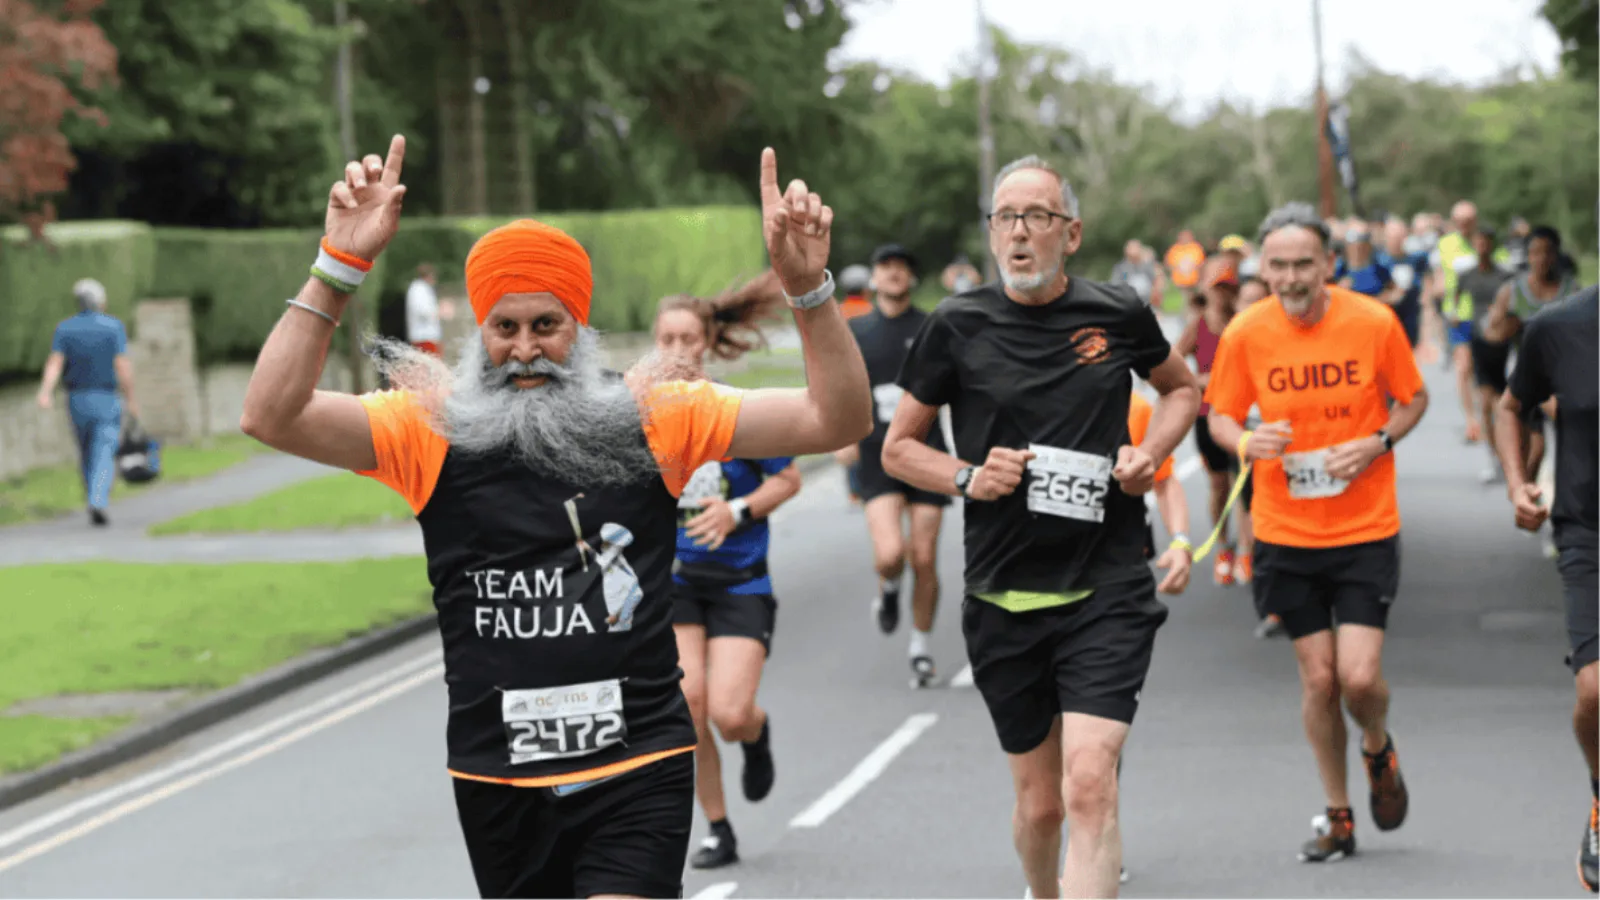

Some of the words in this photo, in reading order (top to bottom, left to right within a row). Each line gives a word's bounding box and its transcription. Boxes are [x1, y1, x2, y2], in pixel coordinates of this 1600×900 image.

[1267, 360, 1360, 393] GUIDE
[1027, 469, 1108, 507] 2662
[465, 568, 564, 598] TEAM
[475, 603, 596, 639] FAUJA
[535, 691, 589, 707] acrns
[510, 712, 621, 753] 2472
